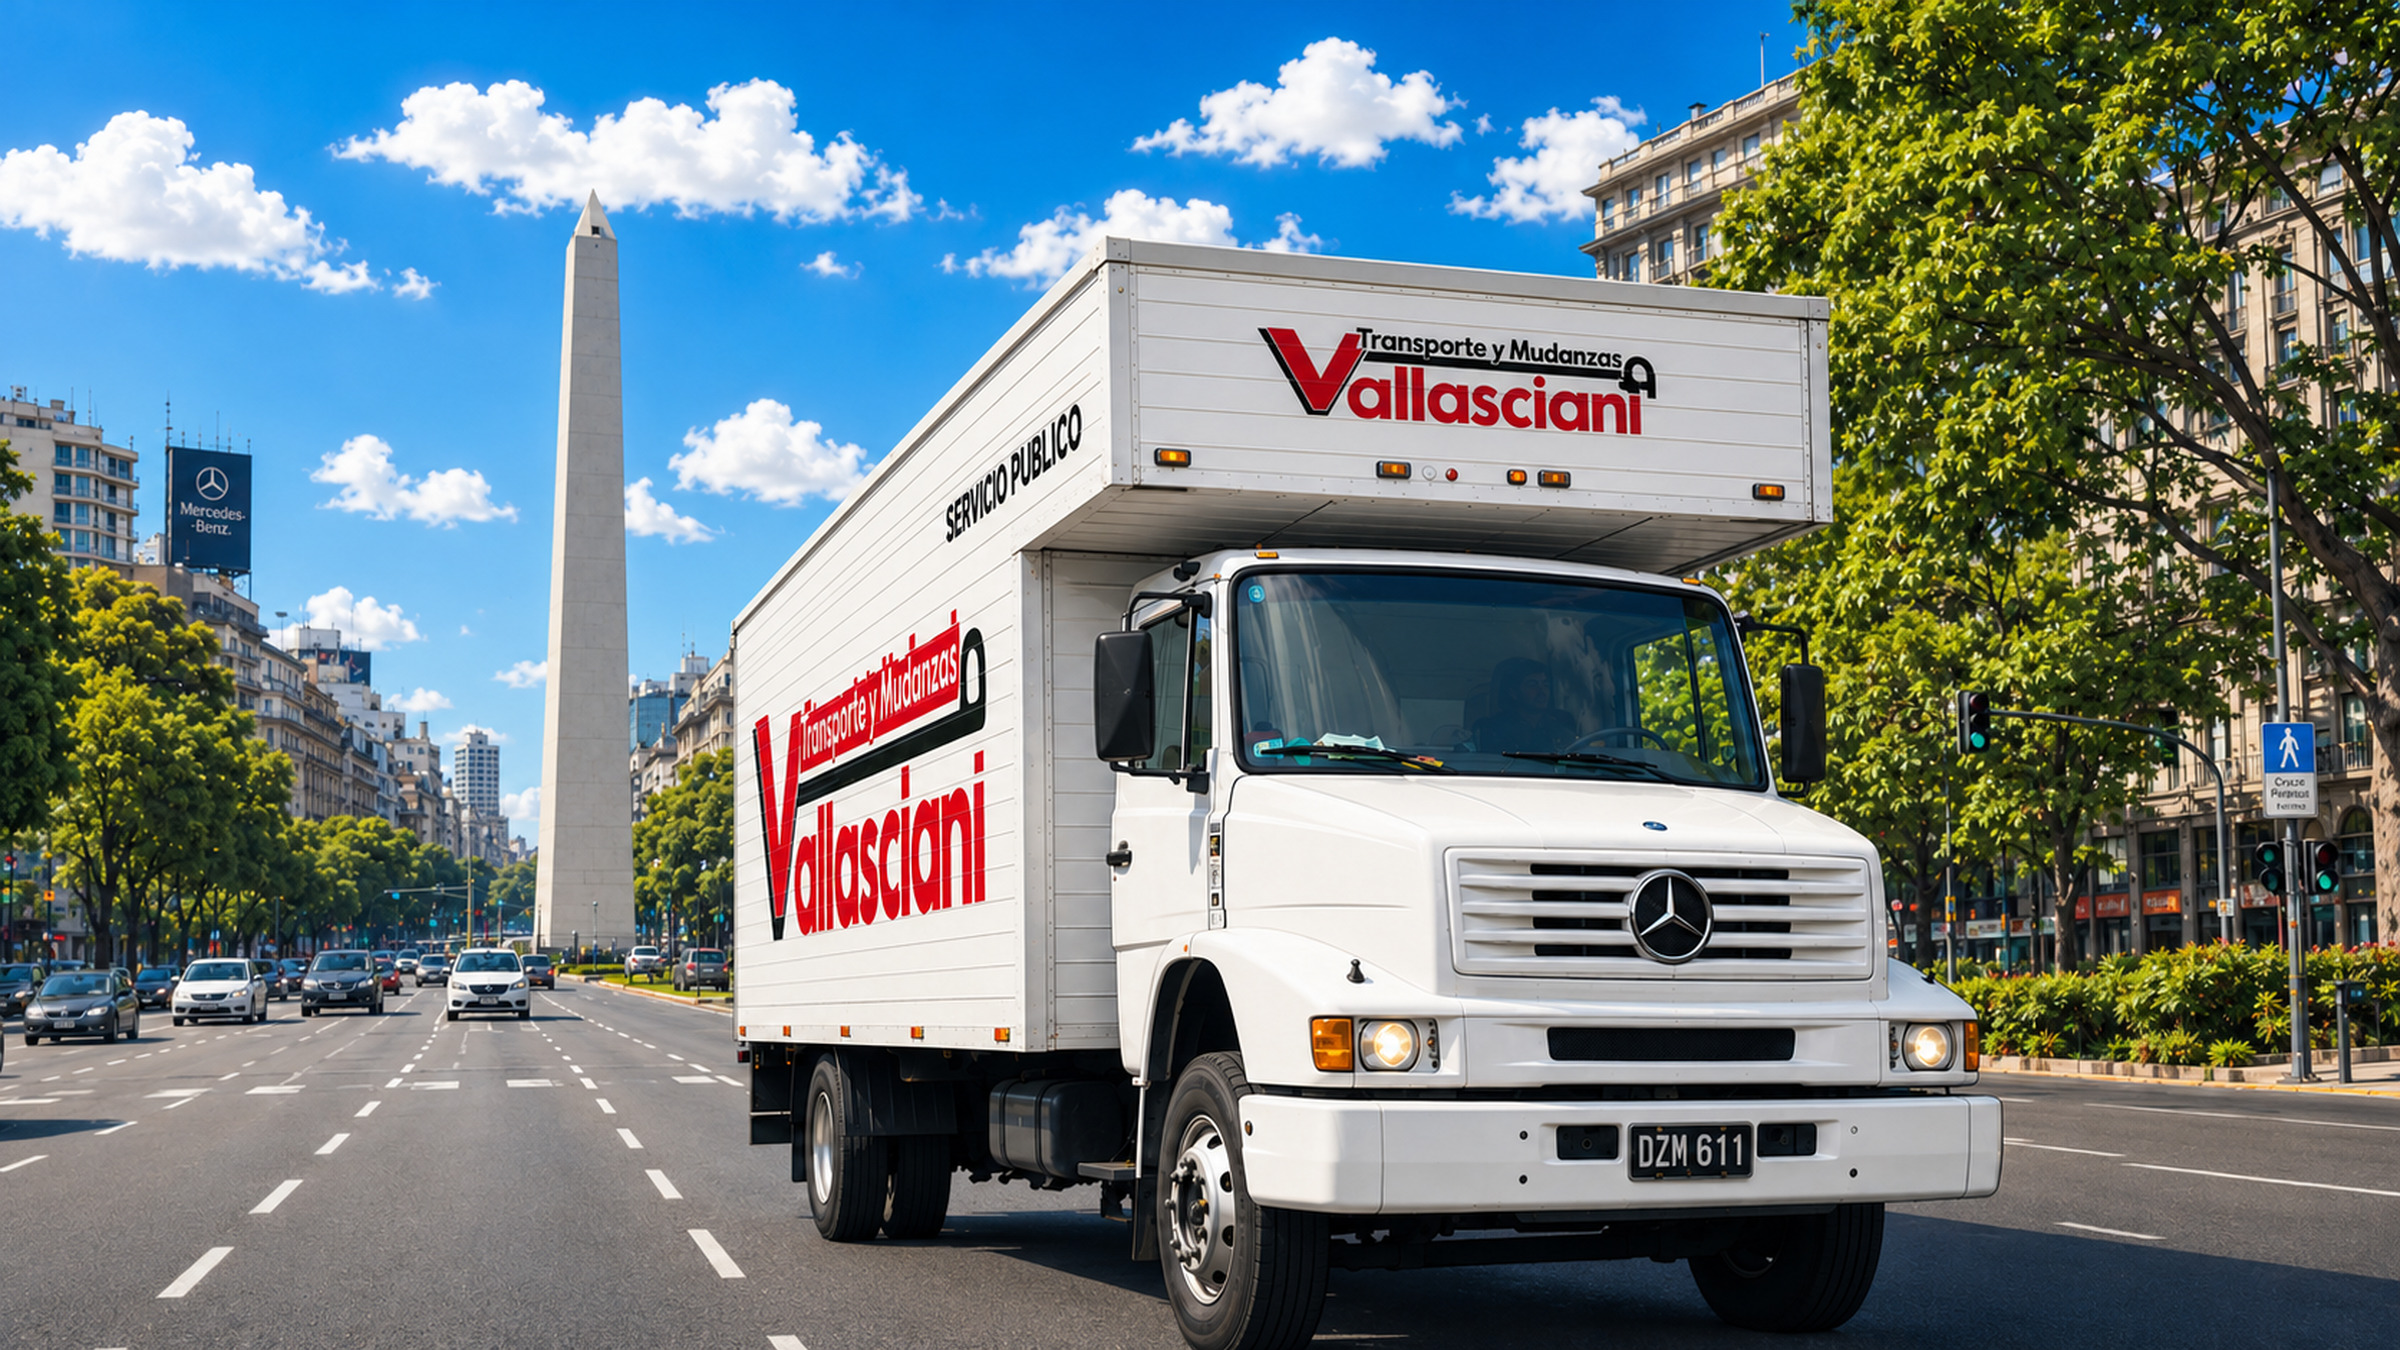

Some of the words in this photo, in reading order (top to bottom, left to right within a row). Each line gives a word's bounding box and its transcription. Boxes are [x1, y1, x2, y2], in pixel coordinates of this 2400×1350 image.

[1257, 327, 1642, 435] Vallasciani
[1356, 327, 1487, 359] Transporte
[1492, 343, 1505, 364] y
[1509, 339, 1623, 369] Mudanzas
[946, 463, 1008, 543] SERVICIO
[1011, 404, 1082, 496] PUBLICO
[801, 690, 866, 761] Transporte
[868, 688, 878, 742] y
[880, 643, 957, 723] Mudanzas
[752, 711, 986, 941] Vallasciani
[1638, 1134, 1688, 1168] DZM
[1696, 1133, 1743, 1167] 611
